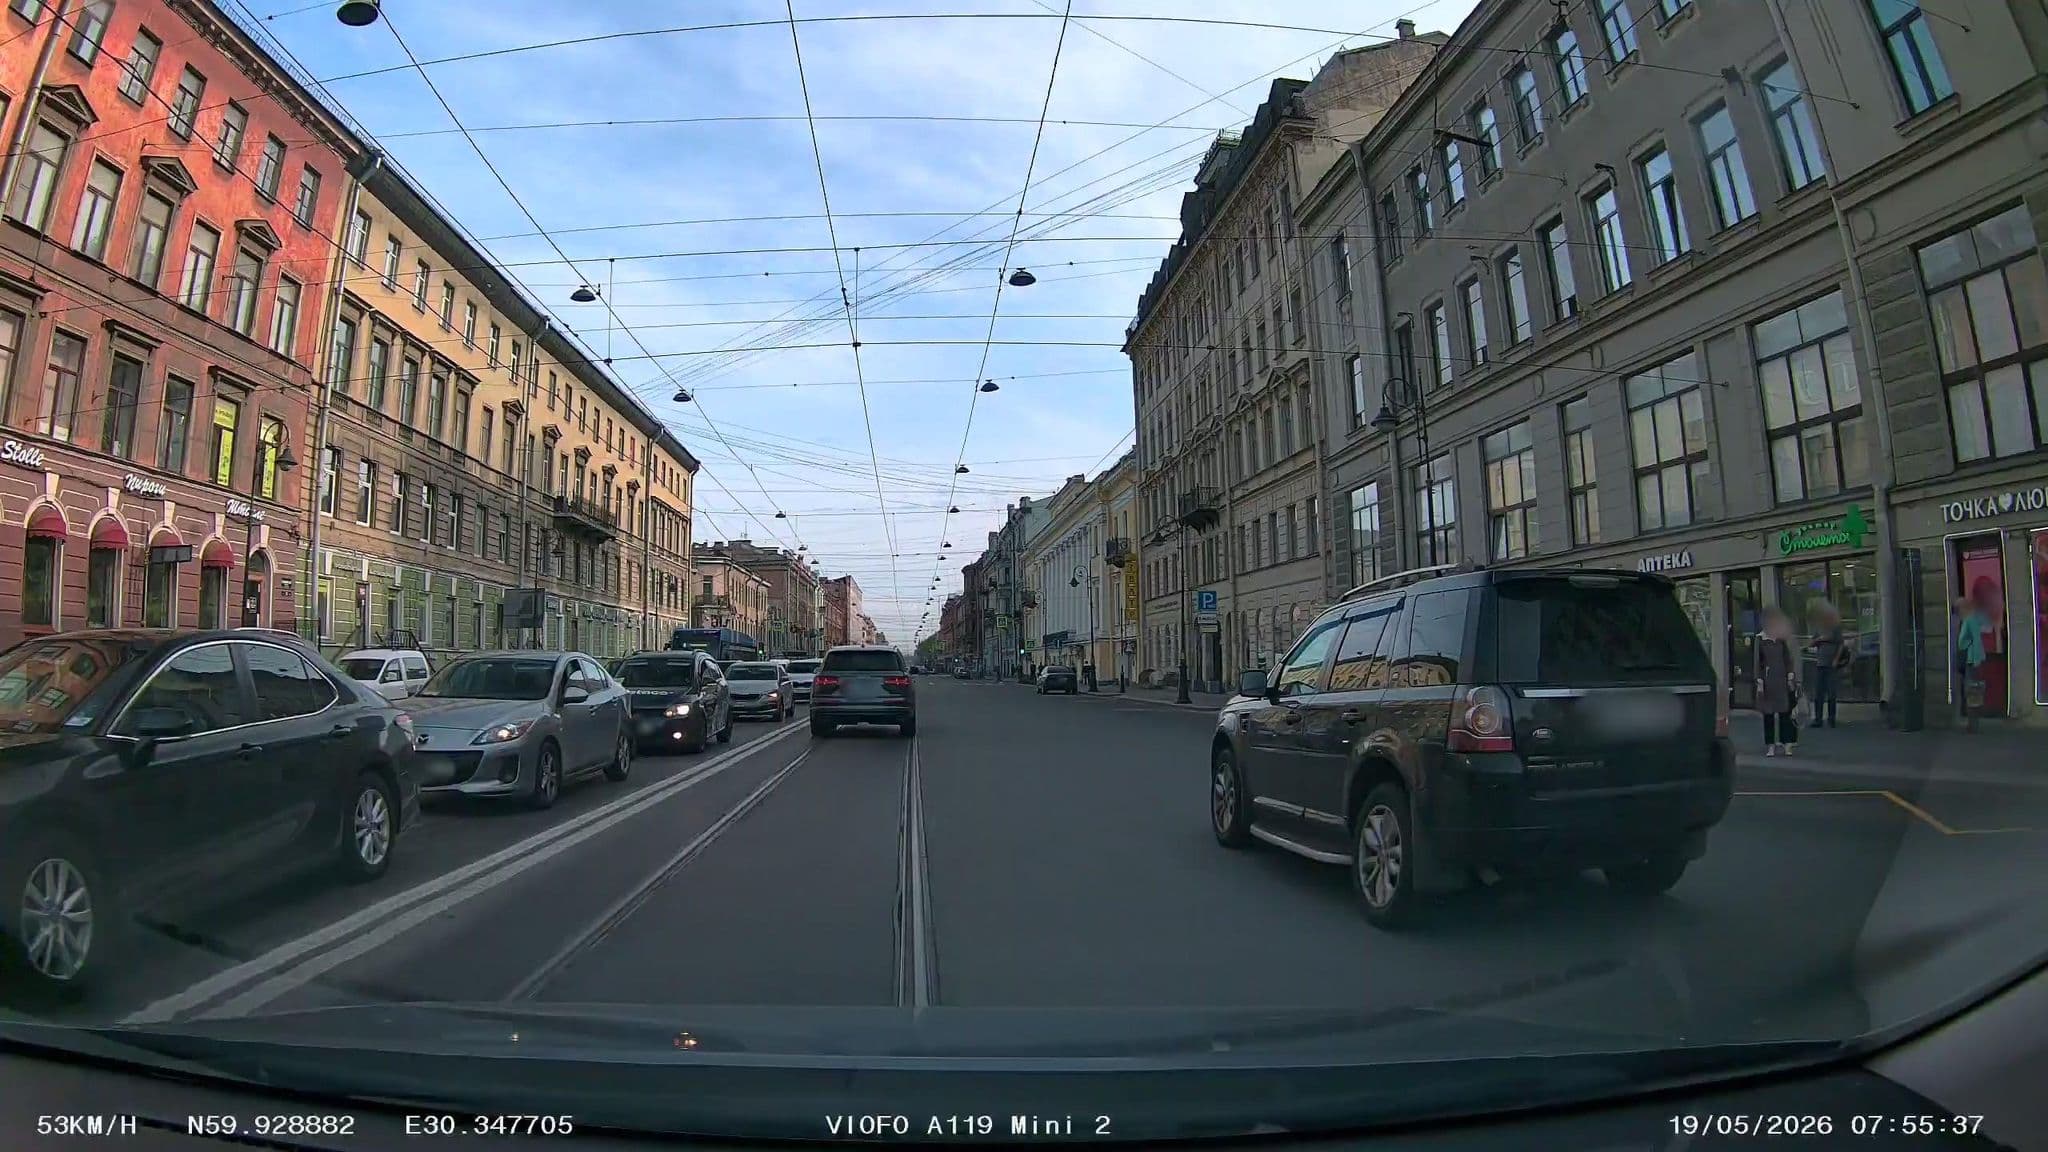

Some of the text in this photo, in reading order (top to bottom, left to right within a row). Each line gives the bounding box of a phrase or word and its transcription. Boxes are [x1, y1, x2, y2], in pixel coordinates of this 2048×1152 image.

[1, 441, 44, 466] Stolle
[125, 473, 166, 495] Пироги
[1940, 487, 2048, 523] ТОЧКА ЛЮ
[1636, 551, 1691, 573] АПТЕКА
